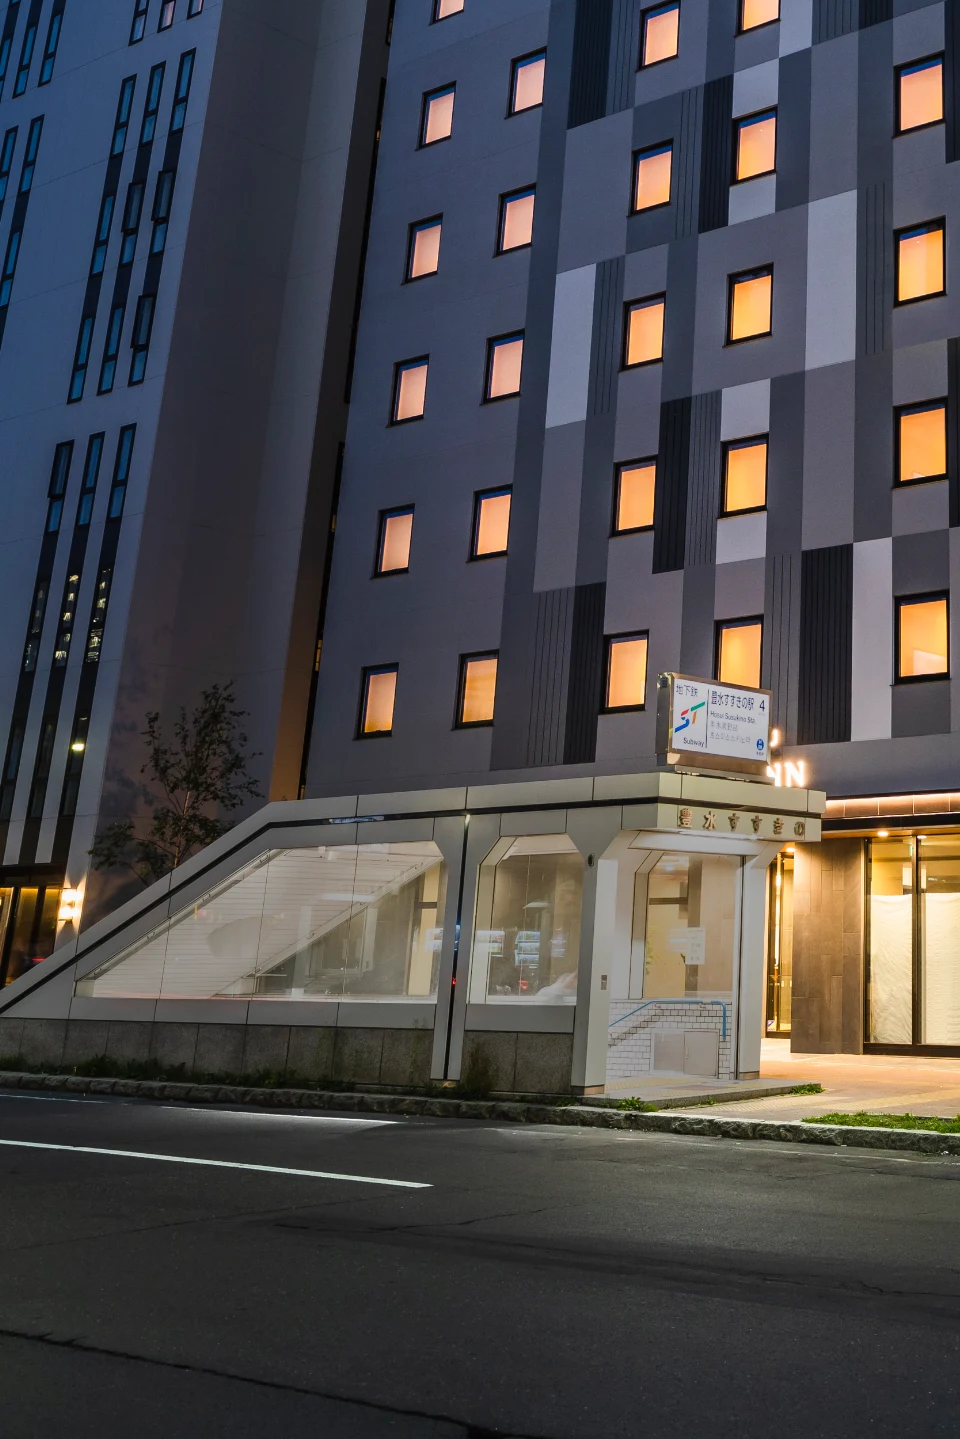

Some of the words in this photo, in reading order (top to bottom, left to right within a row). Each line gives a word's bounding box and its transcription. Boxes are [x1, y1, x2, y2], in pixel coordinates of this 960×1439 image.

[676, 683, 699, 697] 地下鉄
[711, 690, 755, 711] 豊水すすきの駅
[759, 699, 766, 712] 4
[683, 736, 705, 748] Subway
[679, 807, 806, 836] 豊水すすきの
